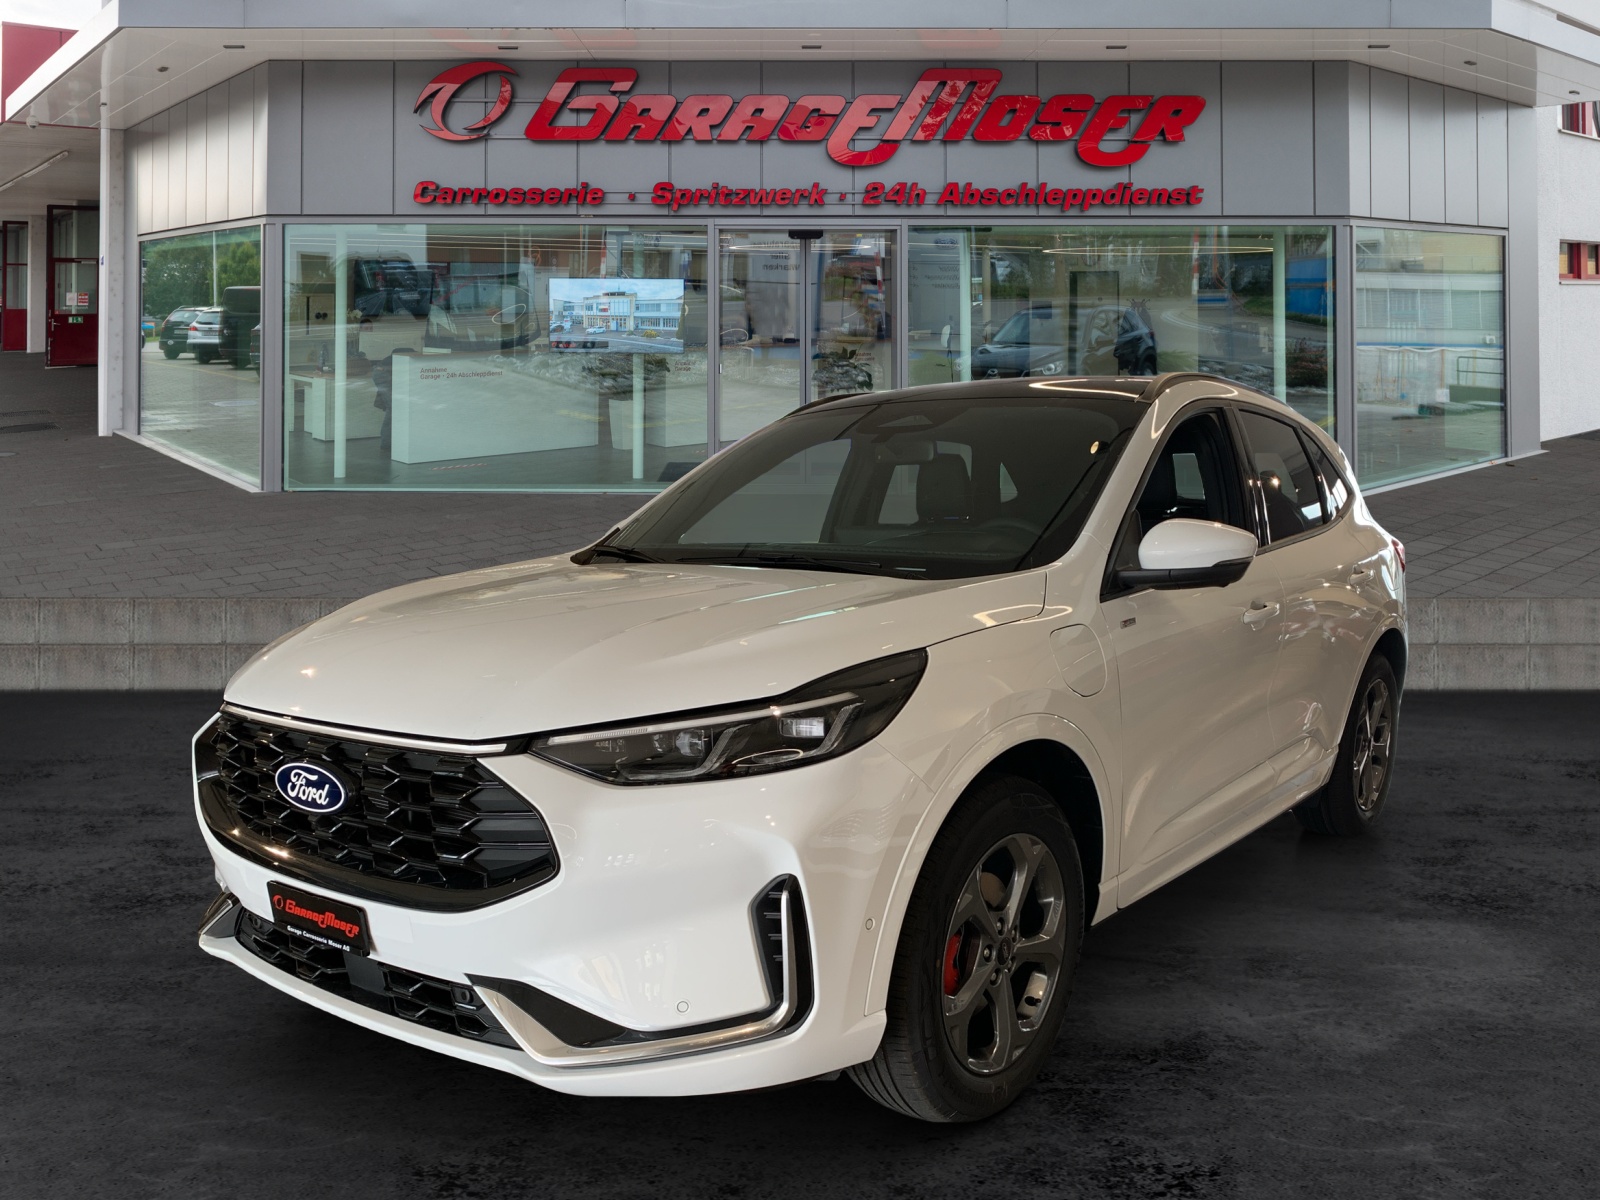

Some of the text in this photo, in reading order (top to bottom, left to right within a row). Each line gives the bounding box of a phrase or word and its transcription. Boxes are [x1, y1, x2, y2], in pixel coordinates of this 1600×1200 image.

[413, 180, 1204, 212] Carrosserie Spritzwerk 24h Abschleppdienst
[287, 768, 330, 806] Ford
[286, 925, 351, 952] Garage Carrosserie Moser AG
